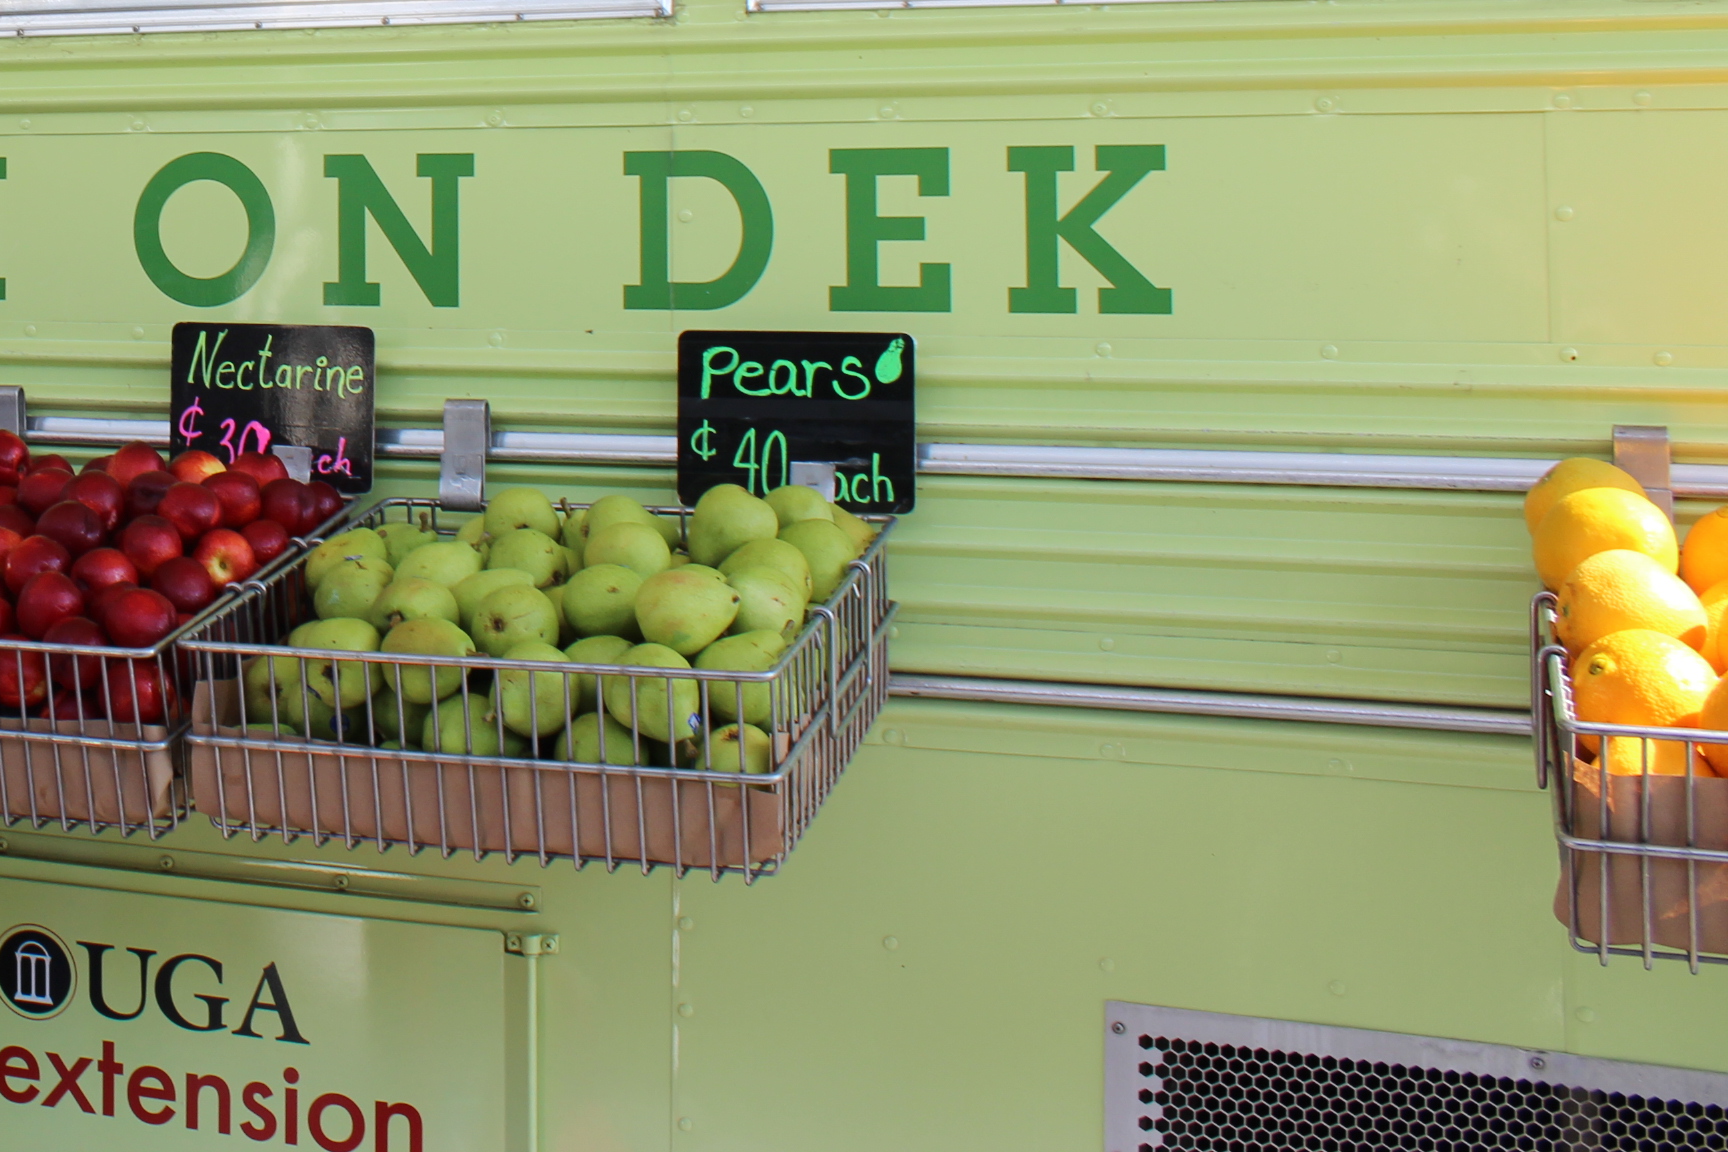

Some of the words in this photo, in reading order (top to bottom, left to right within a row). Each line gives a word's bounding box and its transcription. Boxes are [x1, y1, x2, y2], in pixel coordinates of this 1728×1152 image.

[133, 150, 477, 309] ON
[622, 143, 1175, 316] DEK
[187, 328, 364, 399] Nectarine
[700, 345, 872, 401] Pears
[75, 939, 311, 1046] UGA
